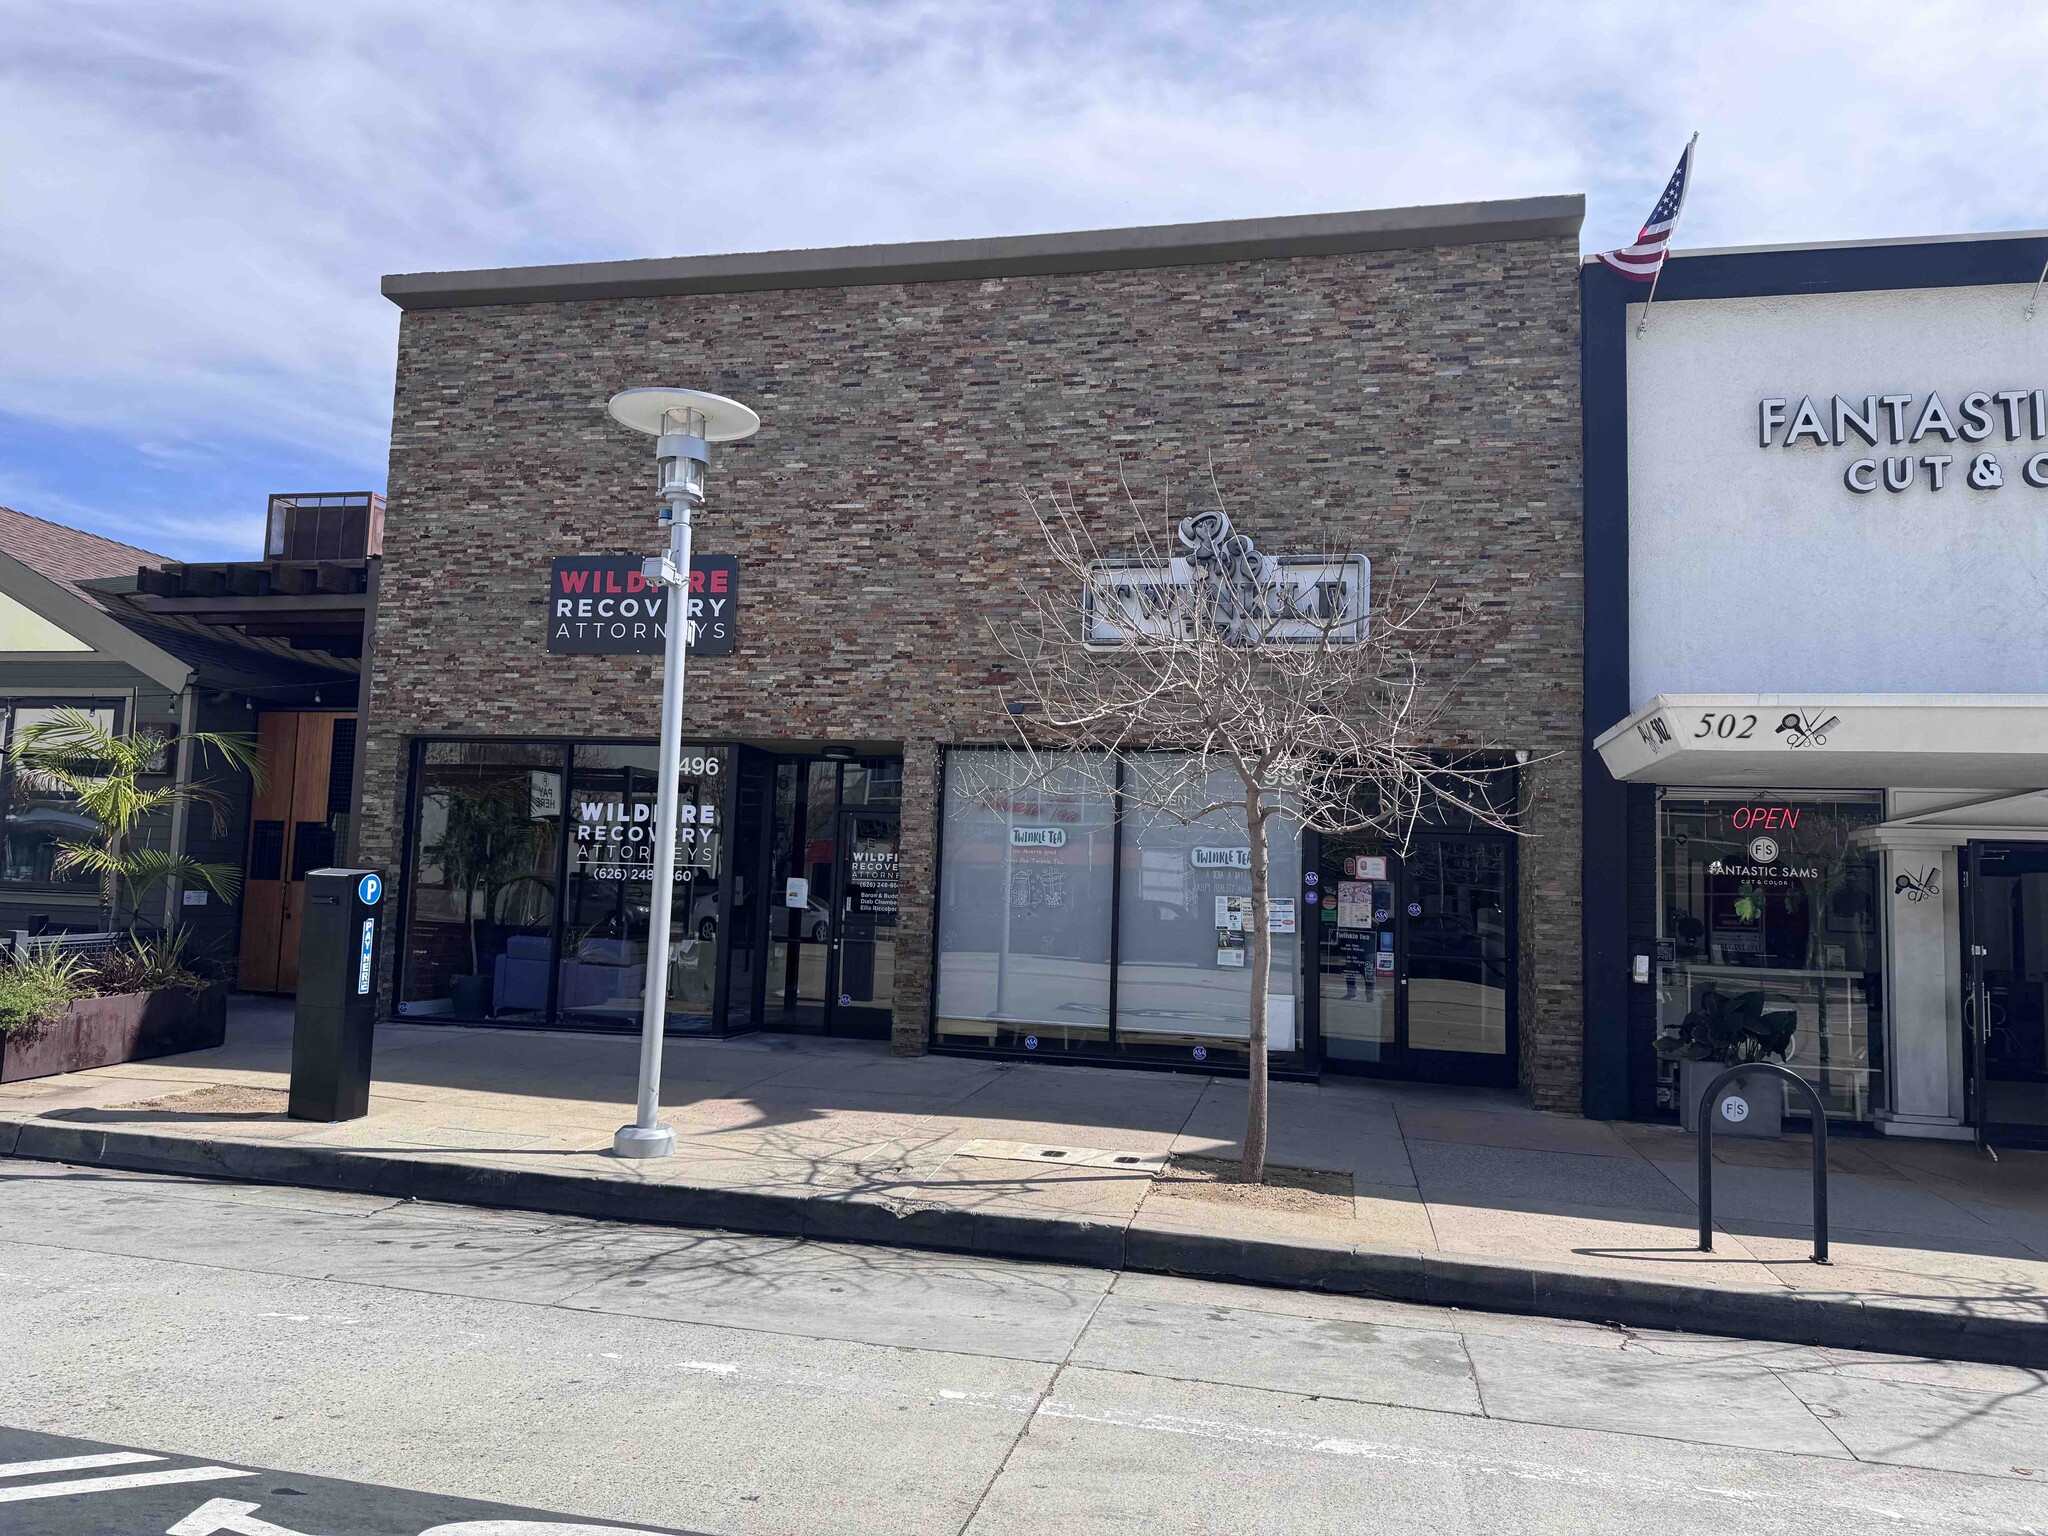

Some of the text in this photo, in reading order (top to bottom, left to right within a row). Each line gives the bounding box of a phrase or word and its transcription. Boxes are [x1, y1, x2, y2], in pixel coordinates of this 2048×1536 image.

[1759, 389, 2048, 447] FANTASTI
[1844, 454, 1953, 493] CUT
[1967, 452, 2004, 490] &
[560, 570, 729, 593] WILDRE
[557, 598, 727, 617] RECOVRY
[556, 622, 725, 639] ATTORNYS
[1694, 713, 1757, 738] 502
[678, 757, 719, 776] 496
[580, 802, 715, 824] WILDRE
[1732, 806, 1801, 830] OPEN
[577, 825, 713, 843] RECORY
[1013, 829, 1063, 845] TWINKLE TEA
[576, 845, 712, 861] ATTOREYS
[1195, 850, 1234, 865] TWINKLE
[593, 868, 692, 882] (626) 24860
[1710, 865, 1818, 878] FANTASTIC SAMS
[366, 880, 377, 900] P
[364, 921, 373, 950] PAY
[361, 953, 370, 990] HERE
